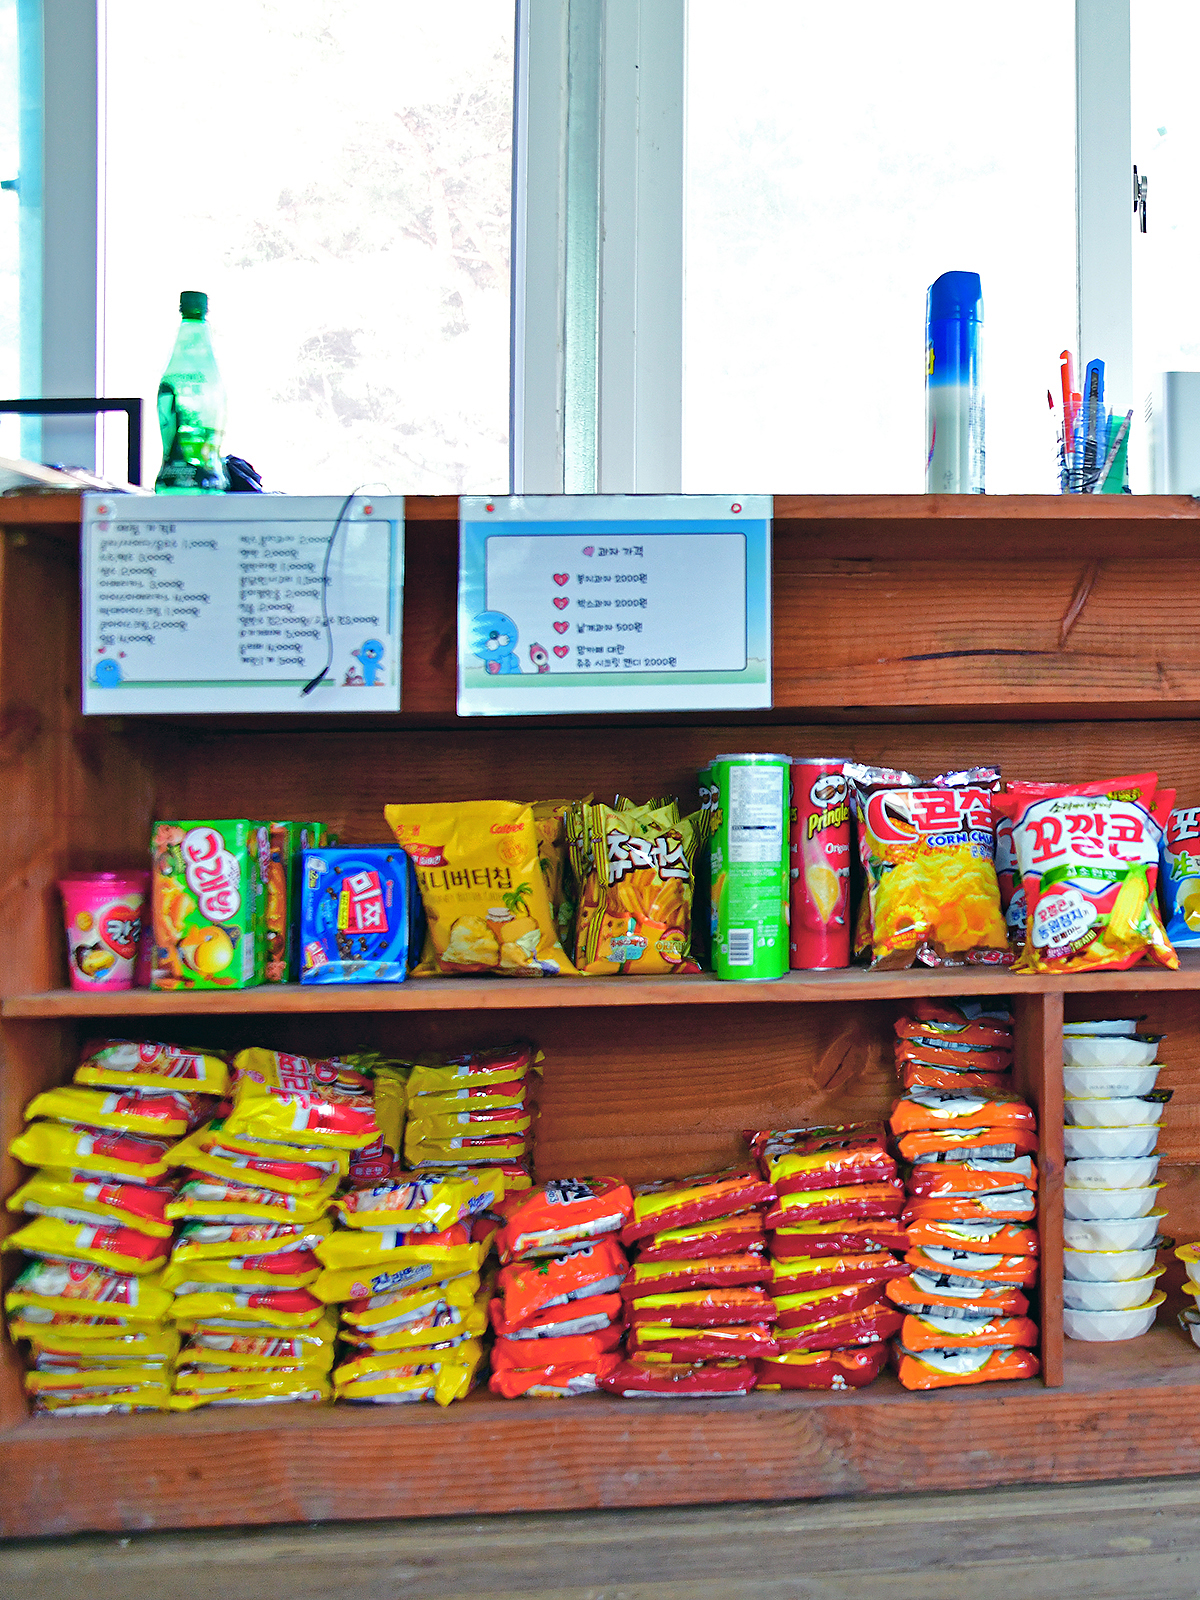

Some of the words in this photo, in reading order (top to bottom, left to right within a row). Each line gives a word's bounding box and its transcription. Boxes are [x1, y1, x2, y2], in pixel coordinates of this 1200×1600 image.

[598, 547, 619, 557] 과자
[623, 546, 644, 557] 가격
[615, 573, 648, 584] 2000원
[615, 598, 648, 609] 2000원
[616, 622, 643, 633] 500원
[644, 656, 677, 667] 2000원
[808, 802, 850, 839] Pringle
[490, 823, 525, 835] Calbee
[927, 832, 968, 848] CORN
[1025, 813, 1144, 865] 꼬깔콘
[1171, 851, 1200, 879] 生
